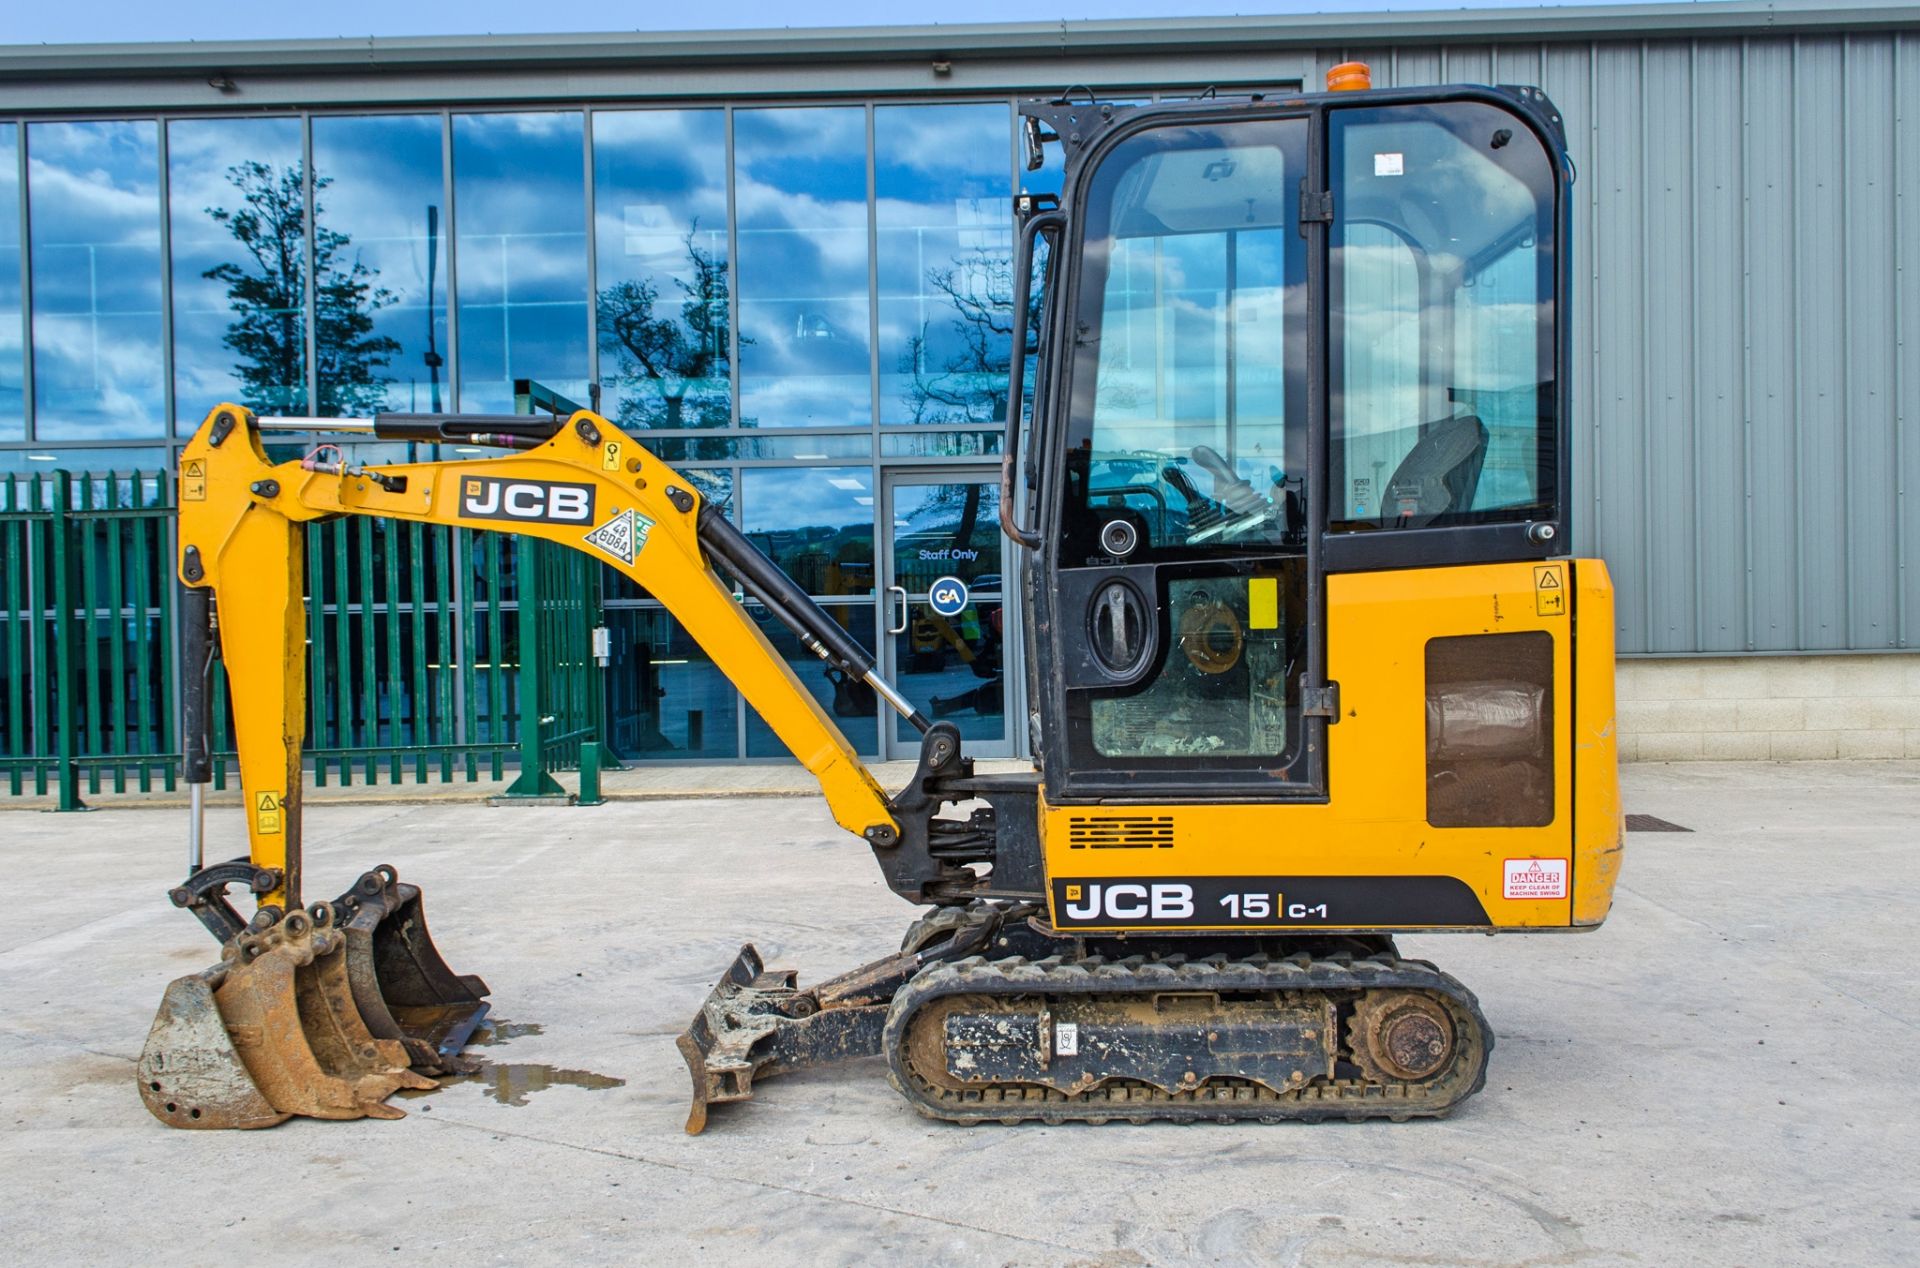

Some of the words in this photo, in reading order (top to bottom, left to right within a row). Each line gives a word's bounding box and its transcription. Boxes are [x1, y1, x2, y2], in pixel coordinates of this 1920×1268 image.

[466, 482, 590, 520] JCB
[613, 523, 628, 538] 48
[599, 529, 628, 553] BD8A
[919, 549, 949, 560] Staff
[951, 548, 979, 562] Only
[1511, 872, 1560, 883] DANGER
[1066, 884, 1194, 919] JCB
[1219, 893, 1270, 919] 15
[1288, 903, 1327, 918] C-1
